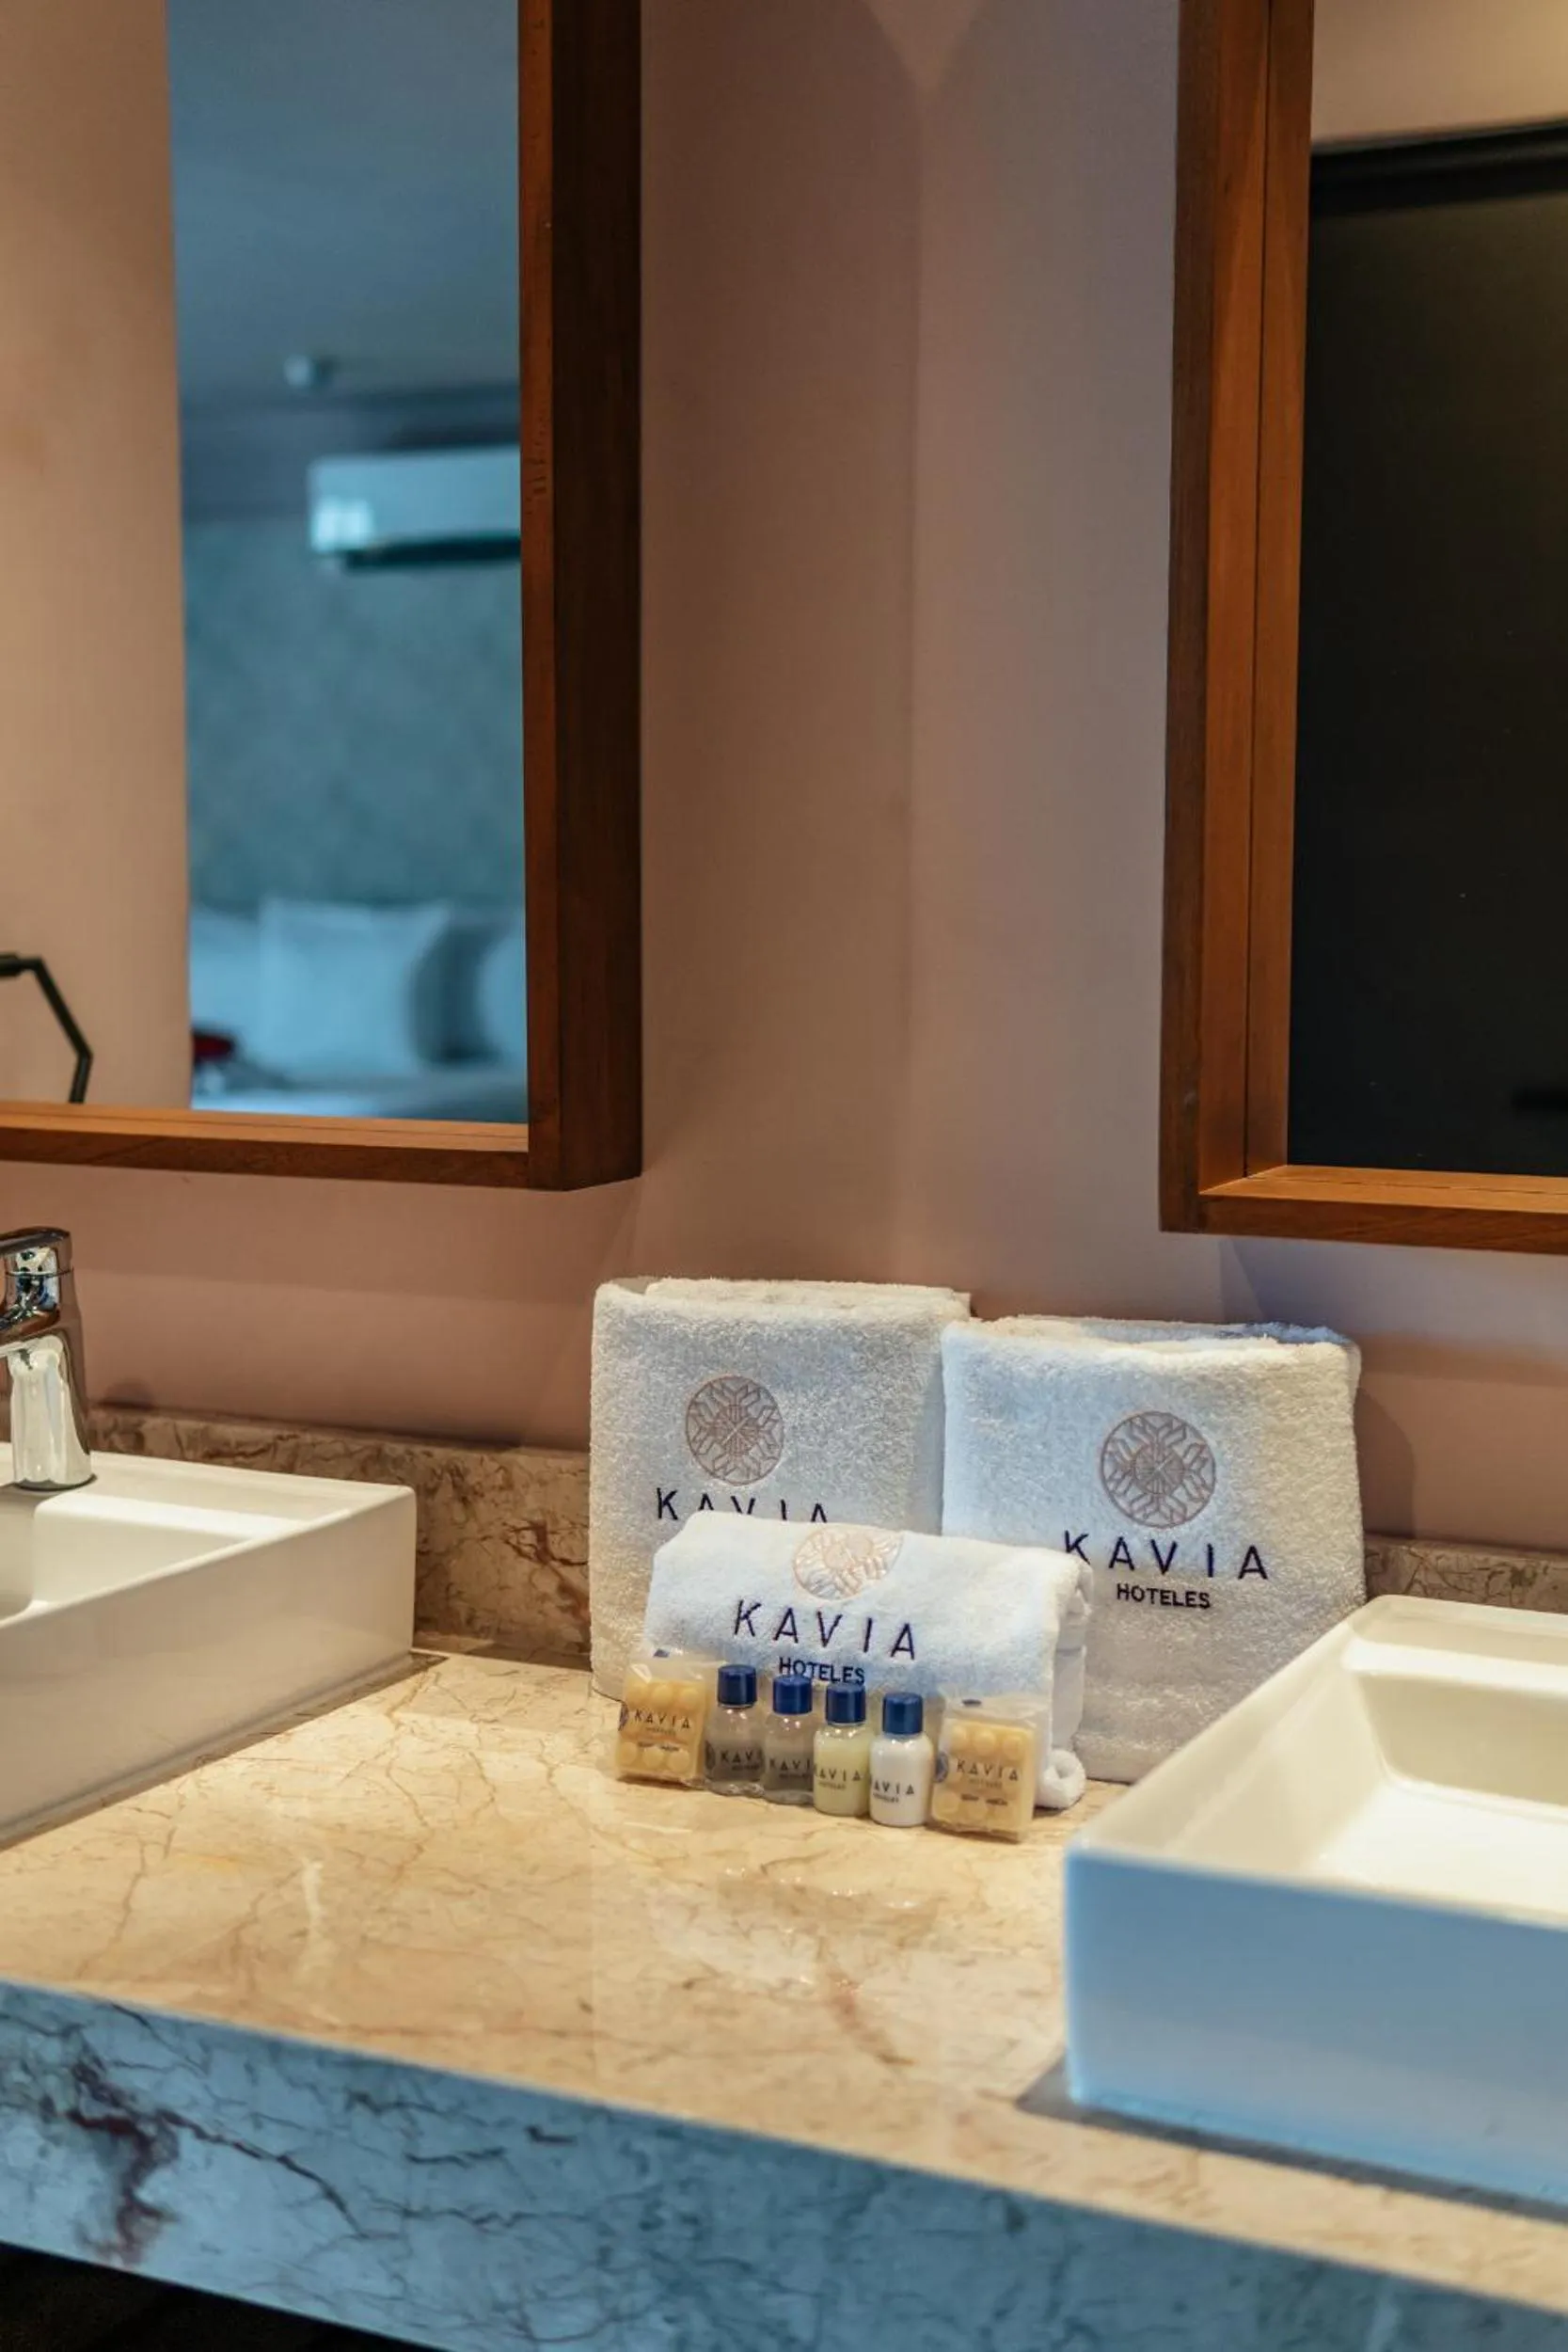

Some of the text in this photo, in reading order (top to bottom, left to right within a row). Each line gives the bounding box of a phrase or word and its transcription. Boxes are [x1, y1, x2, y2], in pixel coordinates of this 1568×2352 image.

[1064, 1530, 1268, 1580] KAVIA
[1117, 1582, 1212, 1610] HOTELES
[734, 1598, 916, 1661] KAVIA
[778, 1657, 865, 1686] HOTELES
[634, 1708, 691, 1729] KAVIA
[768, 1757, 813, 1772] KAVI
[956, 1758, 1019, 1782] KAVIA
[869, 1775, 915, 1795] AVIA
